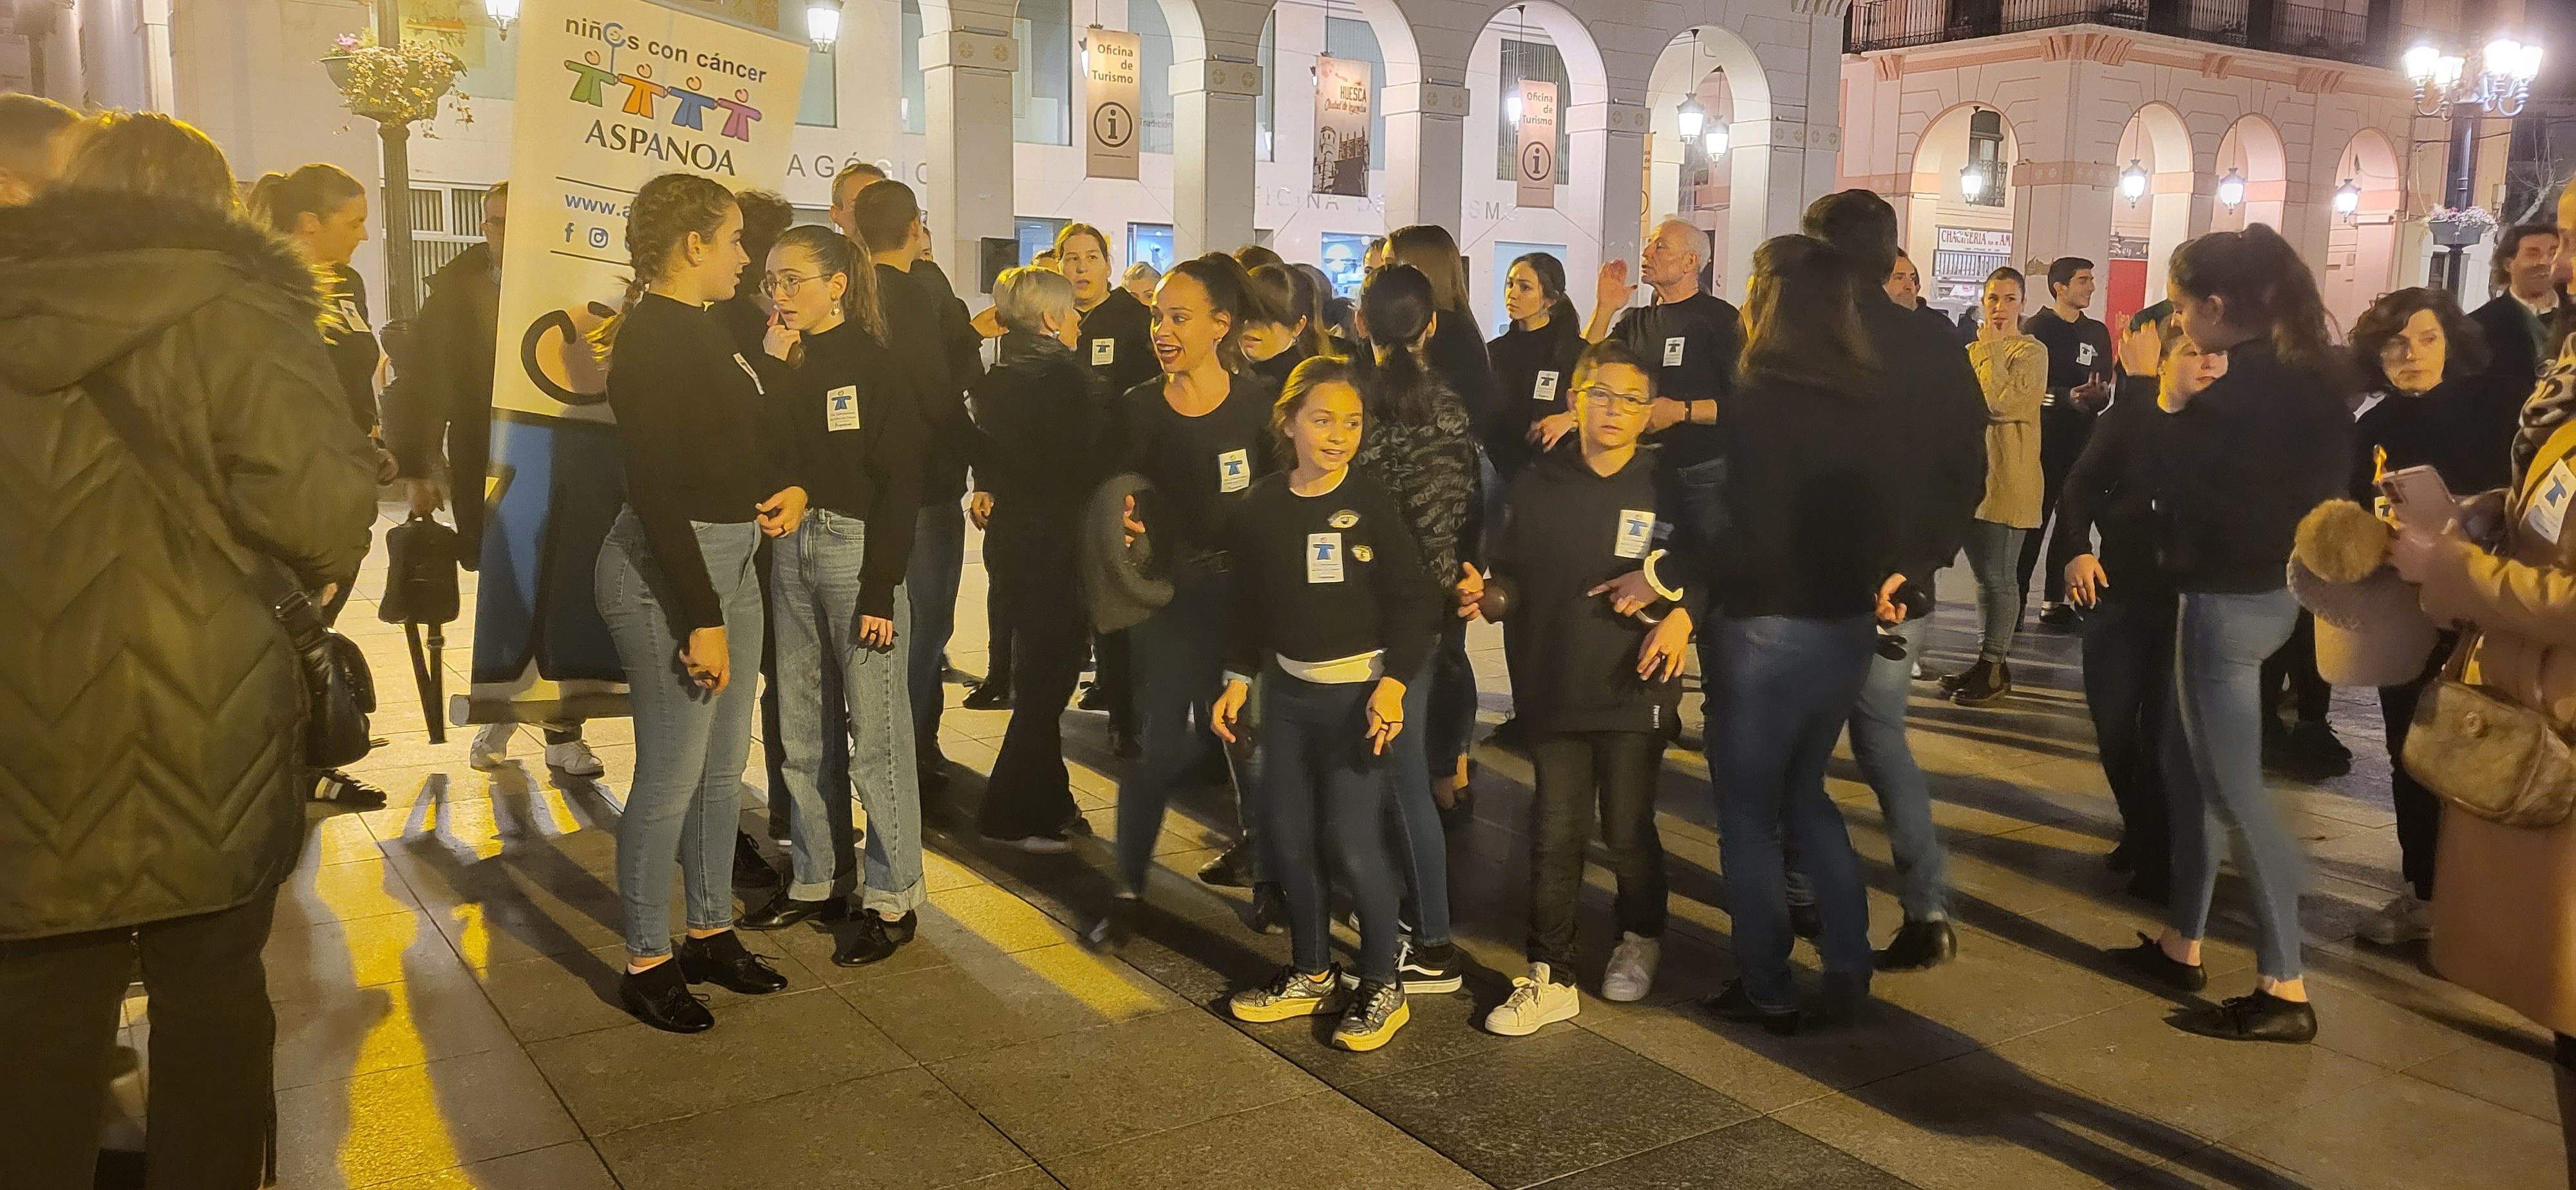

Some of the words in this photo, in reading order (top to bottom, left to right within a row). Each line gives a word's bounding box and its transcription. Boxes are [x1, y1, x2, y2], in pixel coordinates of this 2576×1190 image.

[1097, 44, 1133, 57] Oficina
[648, 41, 688, 64] con
[697, 53, 768, 84] cáncer
[1121, 60, 1133, 70] de
[1092, 70, 1133, 84] Turismo
[1340, 86, 1367, 103] HUESCA
[1527, 92, 1553, 103] Oficina
[1522, 115, 1553, 126] Turismo
[585, 119, 736, 176] ASPANOA
